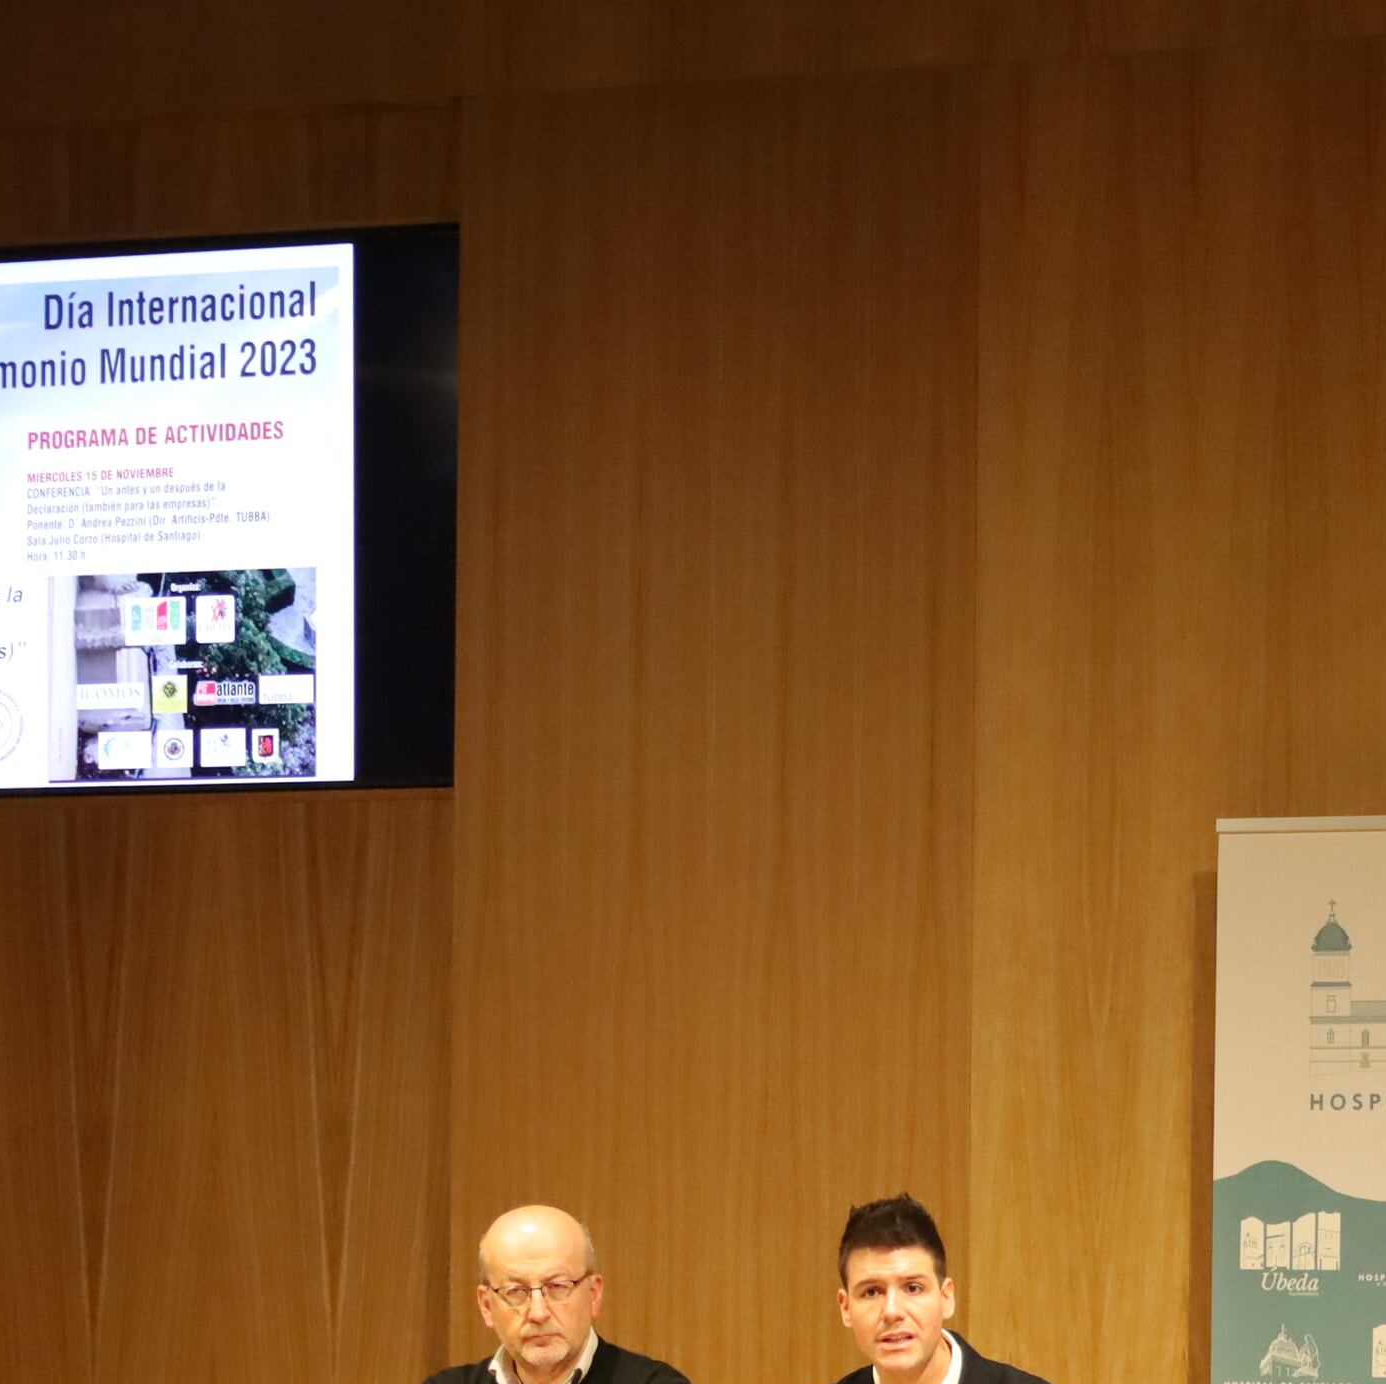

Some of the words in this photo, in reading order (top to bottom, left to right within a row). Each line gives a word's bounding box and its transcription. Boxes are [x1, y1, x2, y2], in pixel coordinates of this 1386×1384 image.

[44, 291, 93, 330] Día
[108, 280, 317, 328] Internacional
[100, 342, 226, 385] Mundial
[240, 338, 317, 378] 2023
[28, 427, 129, 450] PROGRAMA
[135, 426, 157, 445] DE
[164, 420, 284, 444] ACTIVIDADES
[86, 470, 97, 481] 15
[101, 469, 113, 480] DE
[116, 467, 174, 479] NOVIEMBRE
[116, 485, 140, 495] antes
[142, 486, 147, 496] y
[150, 485, 161, 494] un
[204, 481, 214, 491] de
[217, 481, 226, 491] la
[124, 501, 144, 513] para
[147, 499, 160, 510] las
[81, 517, 112, 528] Andrea
[115, 515, 146, 528] Pezzini
[27, 534, 46, 546] Sala
[49, 533, 70, 545] Julio
[73, 532, 97, 545] Corzo
[100, 531, 141, 545] (Hospital
[143, 532, 155, 543] de
[7, 585, 23, 603] la
[216, 682, 254, 696] atlante
[1261, 1267, 1319, 1292] Úbeda
